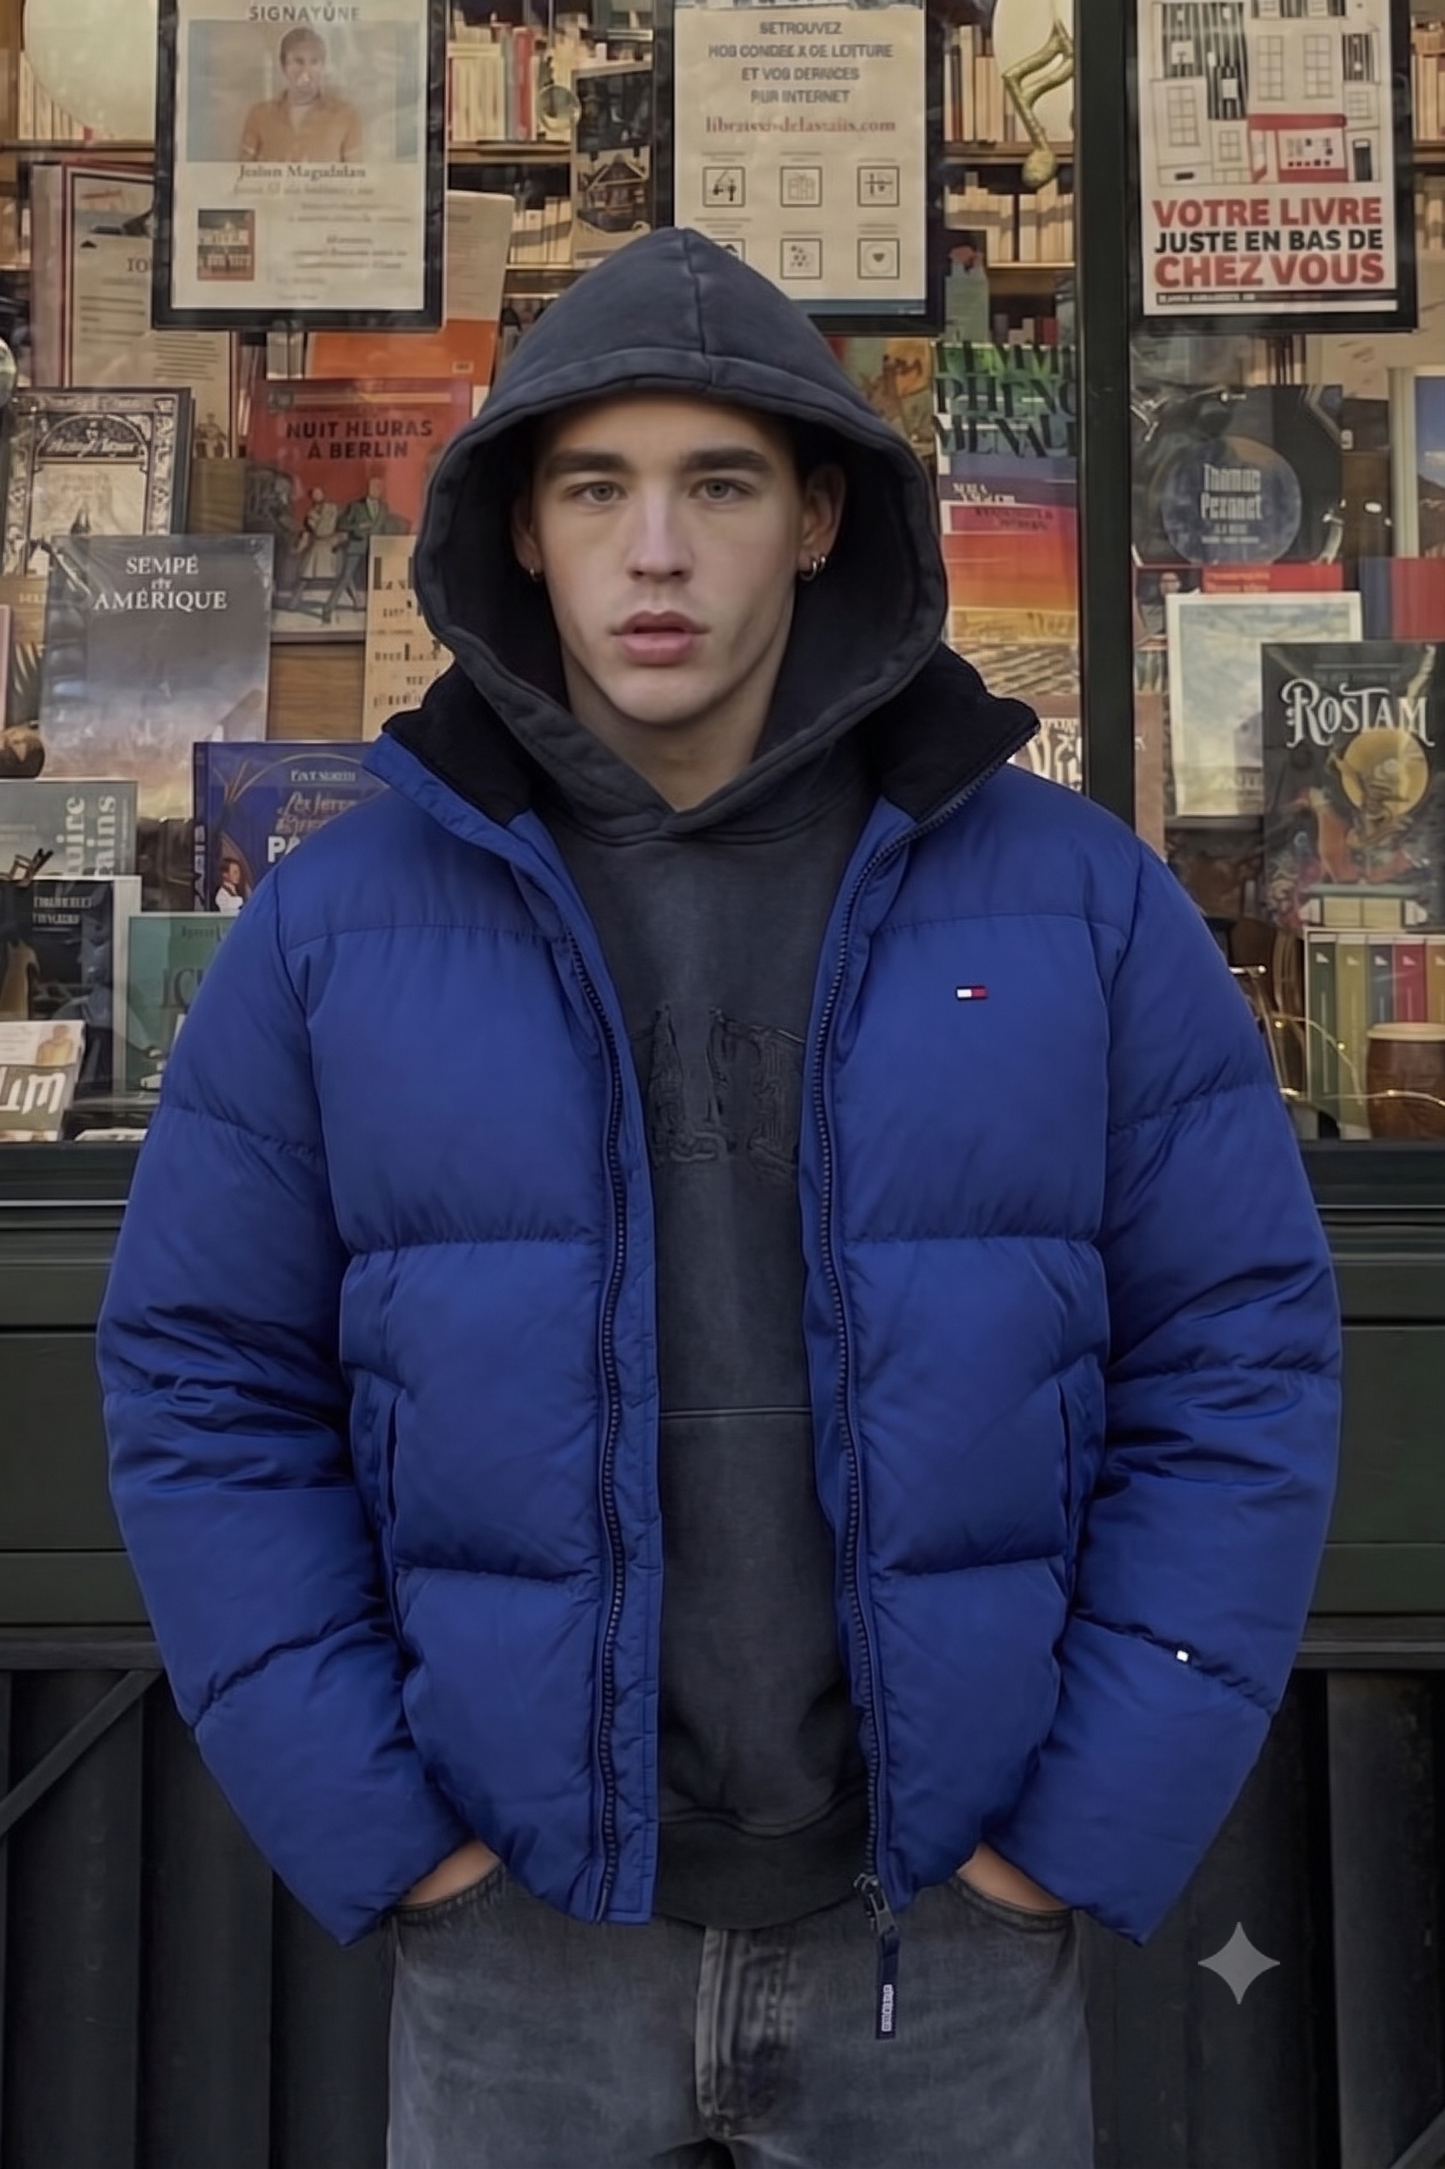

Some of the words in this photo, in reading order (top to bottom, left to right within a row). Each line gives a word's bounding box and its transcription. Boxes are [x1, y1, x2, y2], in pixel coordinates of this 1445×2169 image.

[1152, 199, 1270, 229] VOTRE
[1279, 197, 1382, 226] LIVRE
[1155, 231, 1237, 254] JUSTE
[1245, 230, 1280, 251] EN
[1288, 229, 1341, 251] BAS
[1349, 229, 1383, 250] DE
[1154, 254, 1264, 289] CHEZ
[1270, 252, 1385, 286] VOUS
[286, 421, 339, 438] NUIT
[329, 441, 408, 459] BERLIN
[125, 554, 199, 575] SEMPÉ
[92, 587, 228, 613] AMÉRIQUE
[1281, 678, 1436, 748] ROSTAM
